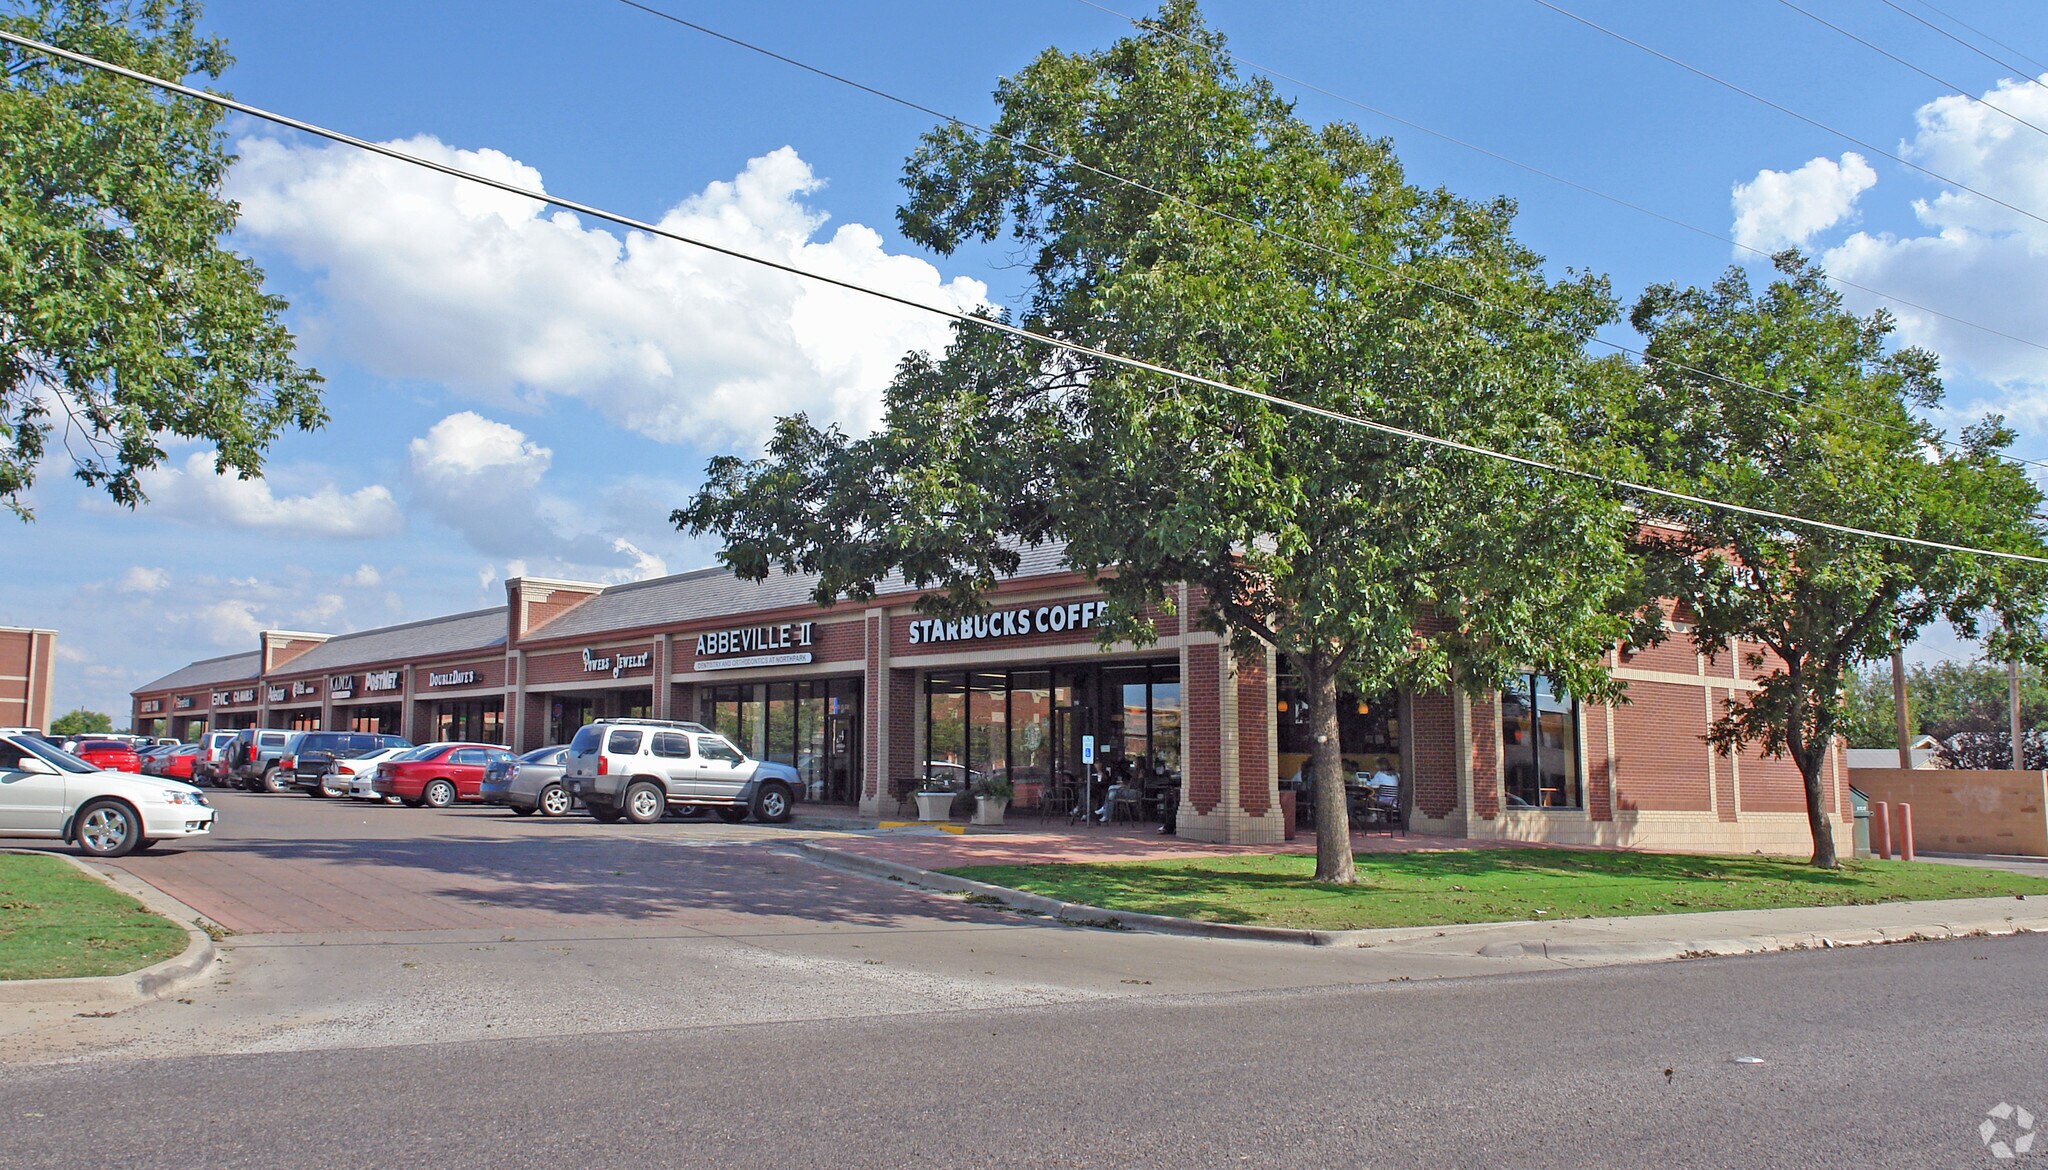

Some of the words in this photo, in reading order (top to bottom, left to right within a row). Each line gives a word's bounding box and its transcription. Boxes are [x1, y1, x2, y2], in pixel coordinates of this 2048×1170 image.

[909, 609, 1031, 644] STARBUCKS
[1035, 601, 1117, 633] COFF
[695, 624, 792, 656] ABBEVILLE
[799, 622, 813, 646] II
[582, 648, 610, 672] POWERS
[612, 652, 649, 679] JEWELRY
[212, 692, 229, 706] GNC
